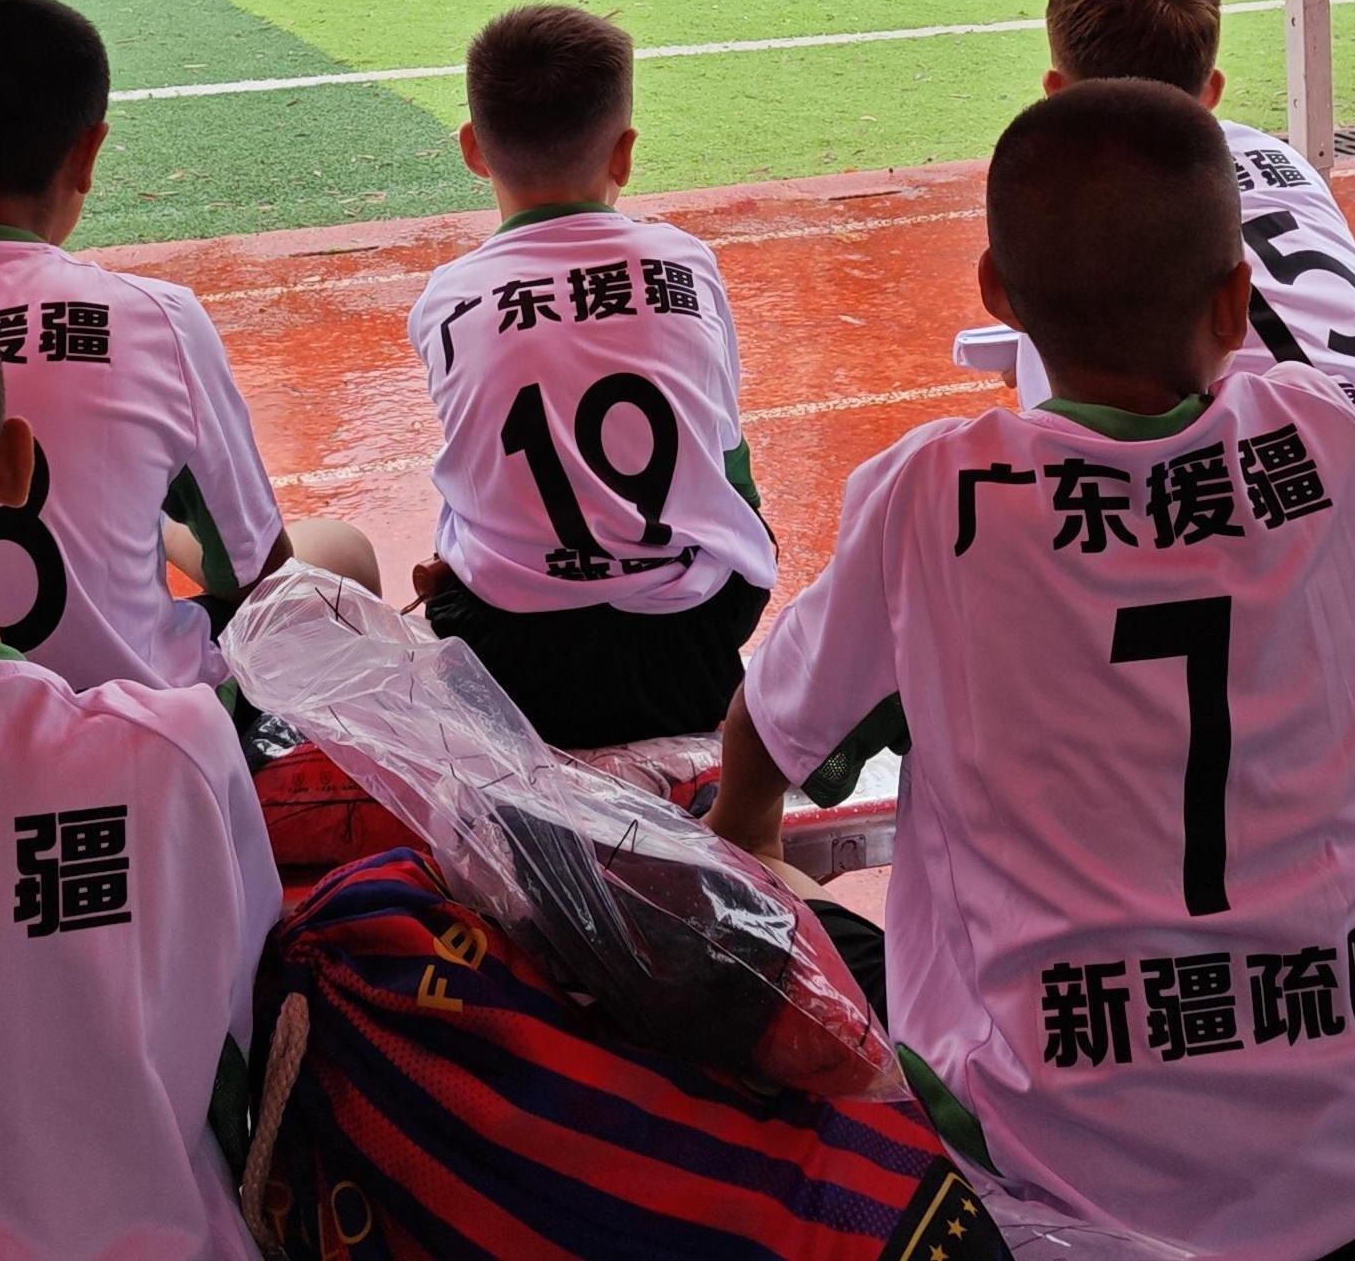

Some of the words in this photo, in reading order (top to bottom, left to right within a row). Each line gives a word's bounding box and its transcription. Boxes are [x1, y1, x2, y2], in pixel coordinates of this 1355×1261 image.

[440, 259, 703, 376] 广东援疆
[500, 372, 679, 561] 19
[954, 423, 1334, 558] 广东援疆
[1110, 595, 1233, 917] 7
